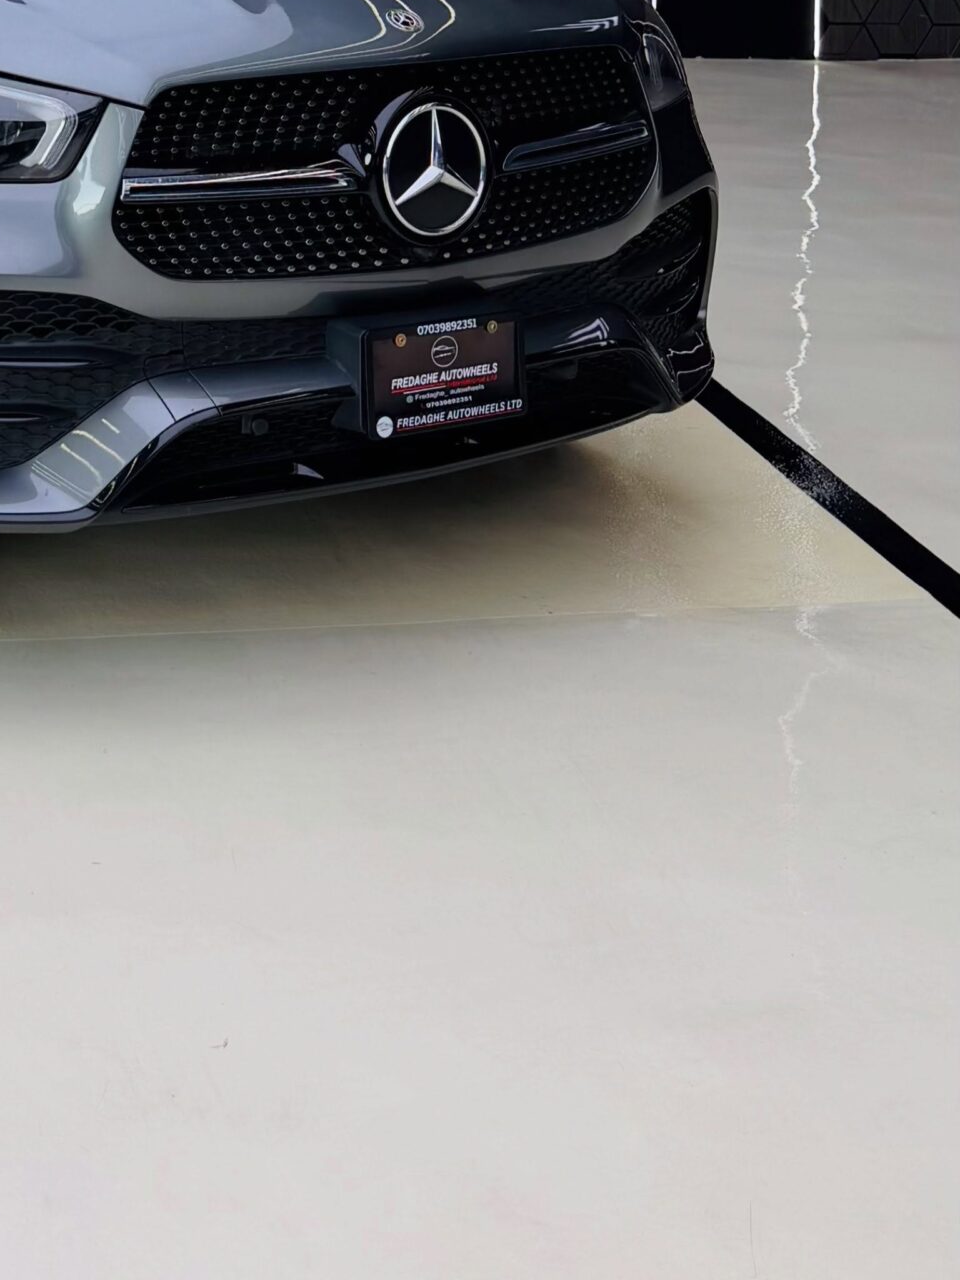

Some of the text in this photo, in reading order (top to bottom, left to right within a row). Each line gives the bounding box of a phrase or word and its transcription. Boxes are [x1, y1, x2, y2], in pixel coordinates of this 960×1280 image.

[417, 318, 477, 335] 07039892351
[391, 362, 498, 390] FREDAGHE AUTOWHEELS
[397, 399, 523, 429] FREDAGHE AUTOWHEELS LTD
